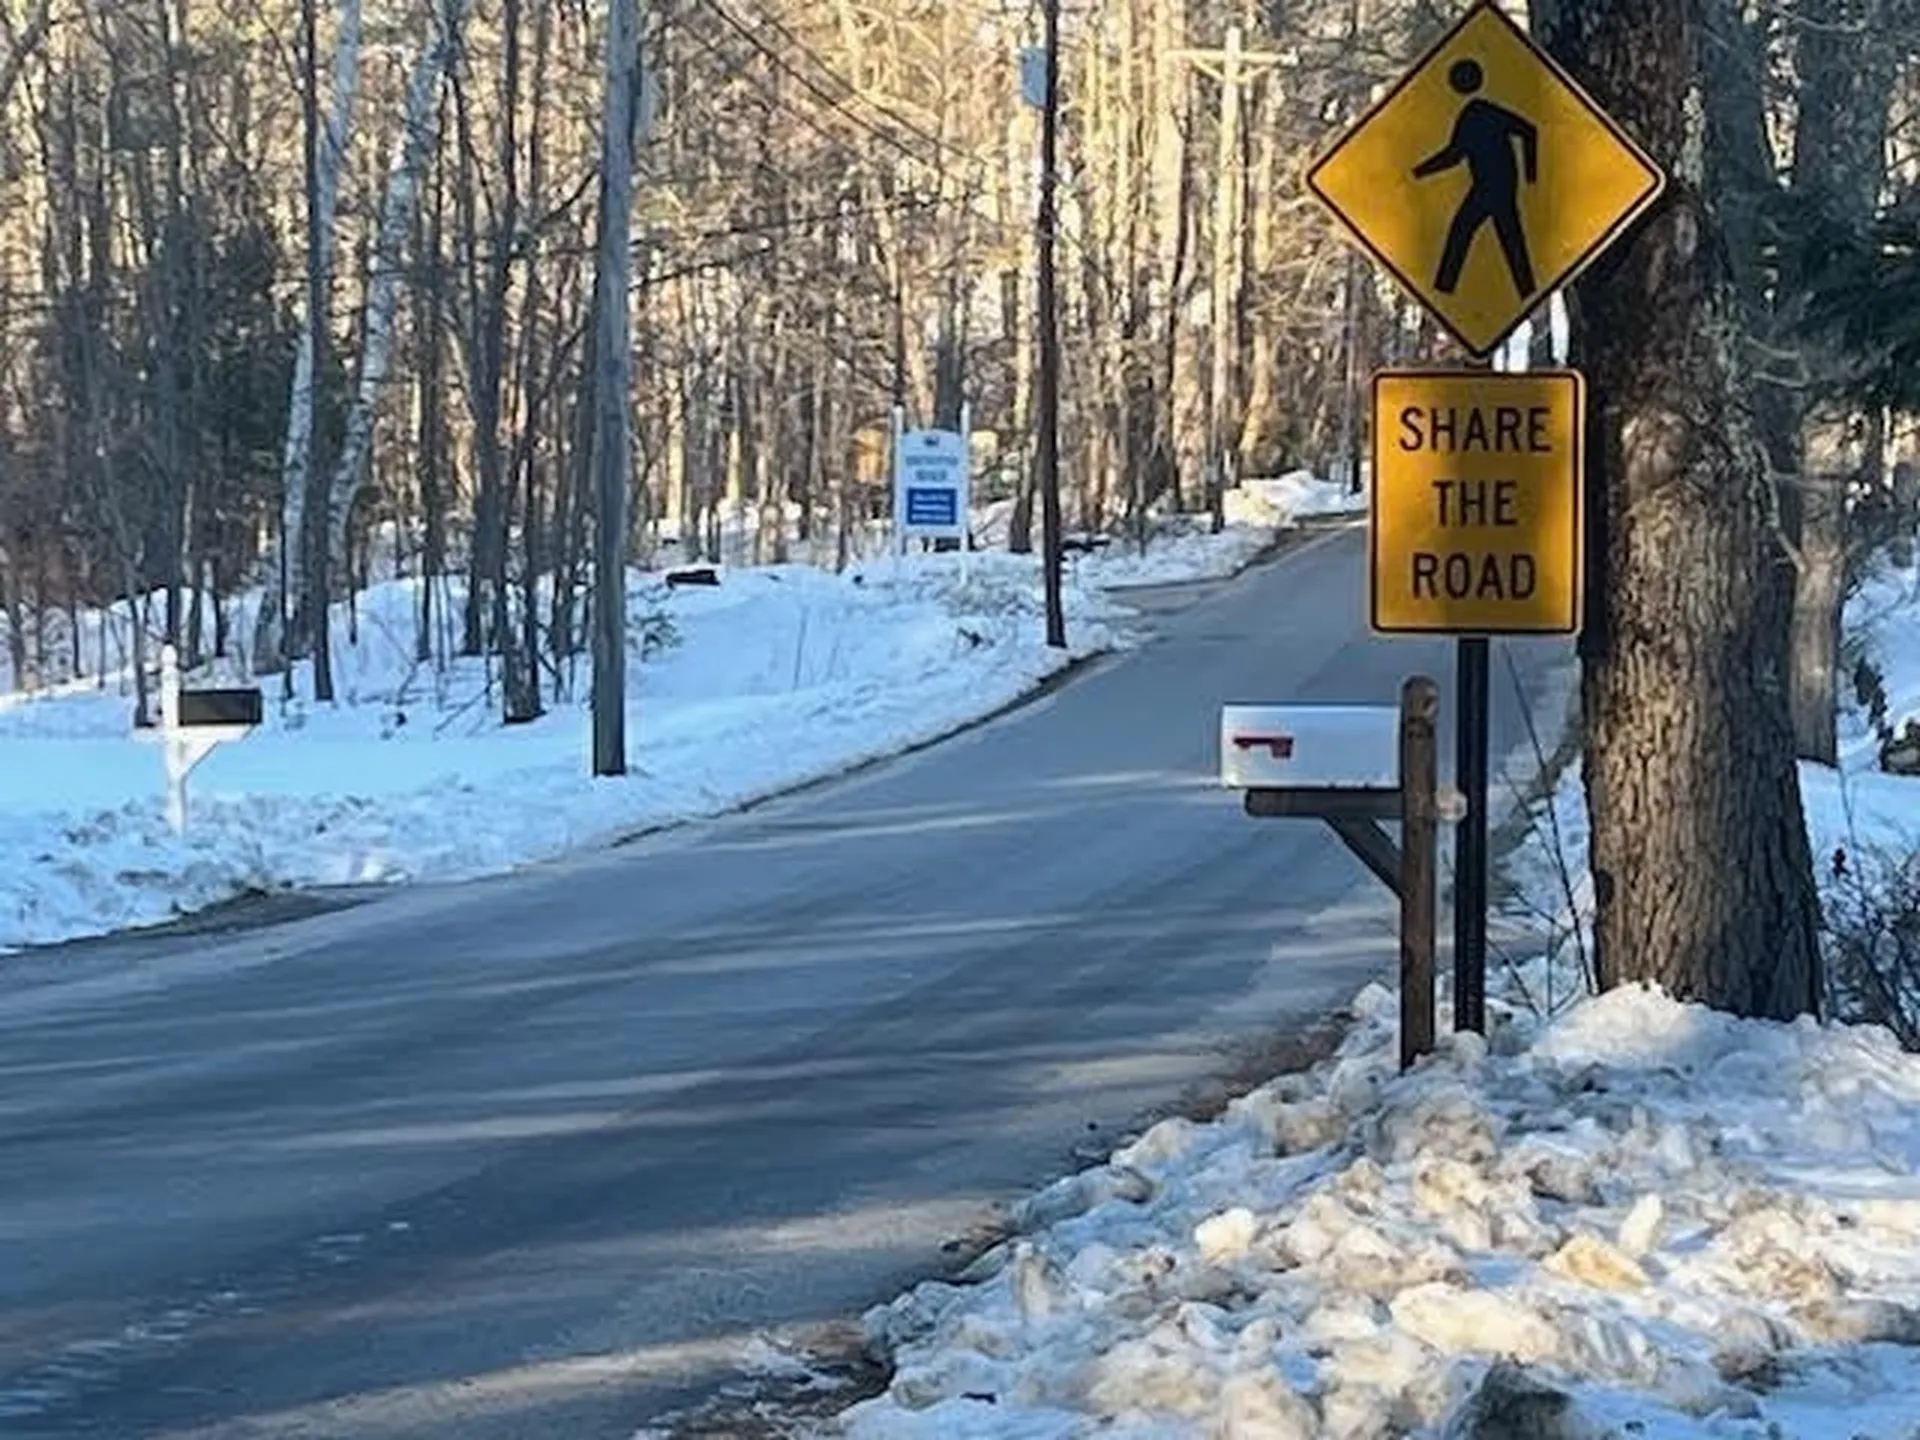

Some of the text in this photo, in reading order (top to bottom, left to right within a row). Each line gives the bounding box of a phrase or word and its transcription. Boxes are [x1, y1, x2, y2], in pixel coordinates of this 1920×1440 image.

[1399, 407, 1552, 451] SHARE
[1432, 480, 1517, 526] THE
[1412, 553, 1536, 598] ROAD
